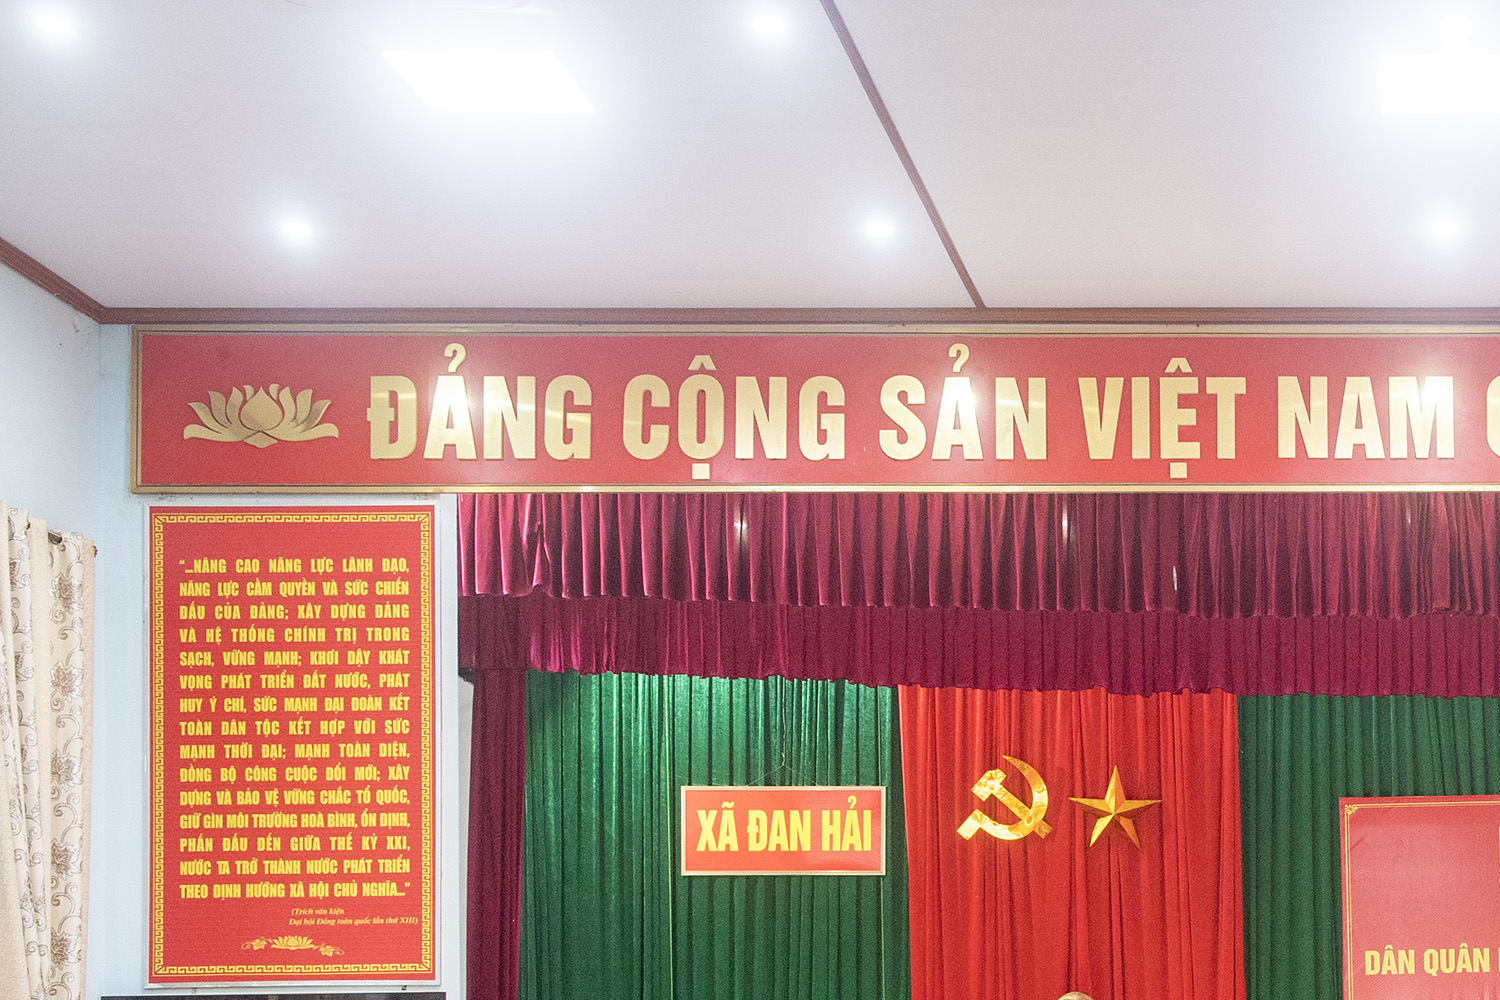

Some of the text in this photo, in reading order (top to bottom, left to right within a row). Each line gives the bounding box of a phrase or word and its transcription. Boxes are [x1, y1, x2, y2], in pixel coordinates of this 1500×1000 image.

[366, 343, 592, 460] ĐẢNG
[622, 355, 844, 480] CỘNG
[878, 344, 1054, 460] SẢN
[1077, 357, 1247, 480] VIỆT
[1277, 374, 1453, 460] NAM
[180, 624, 409, 644] VÀ HỆ THỐNG CHÍNH TRỊ TRONG
[180, 648, 410, 668] SẠCH, VỮNG MẠNH; KHƠI DẬY KHÁT
[180, 716, 409, 737] TOÀN DÂN TỘC KẾT HỢP VỚI SỨC
[180, 741, 410, 760] MẠNH THỜI ĐẠI; MẠNH TOÀN DIỆN,
[697, 796, 871, 851] XÃ ĐAN HẢI
[1365, 945, 1415, 975] DÂN
[1423, 943, 1490, 976] QUÂN
